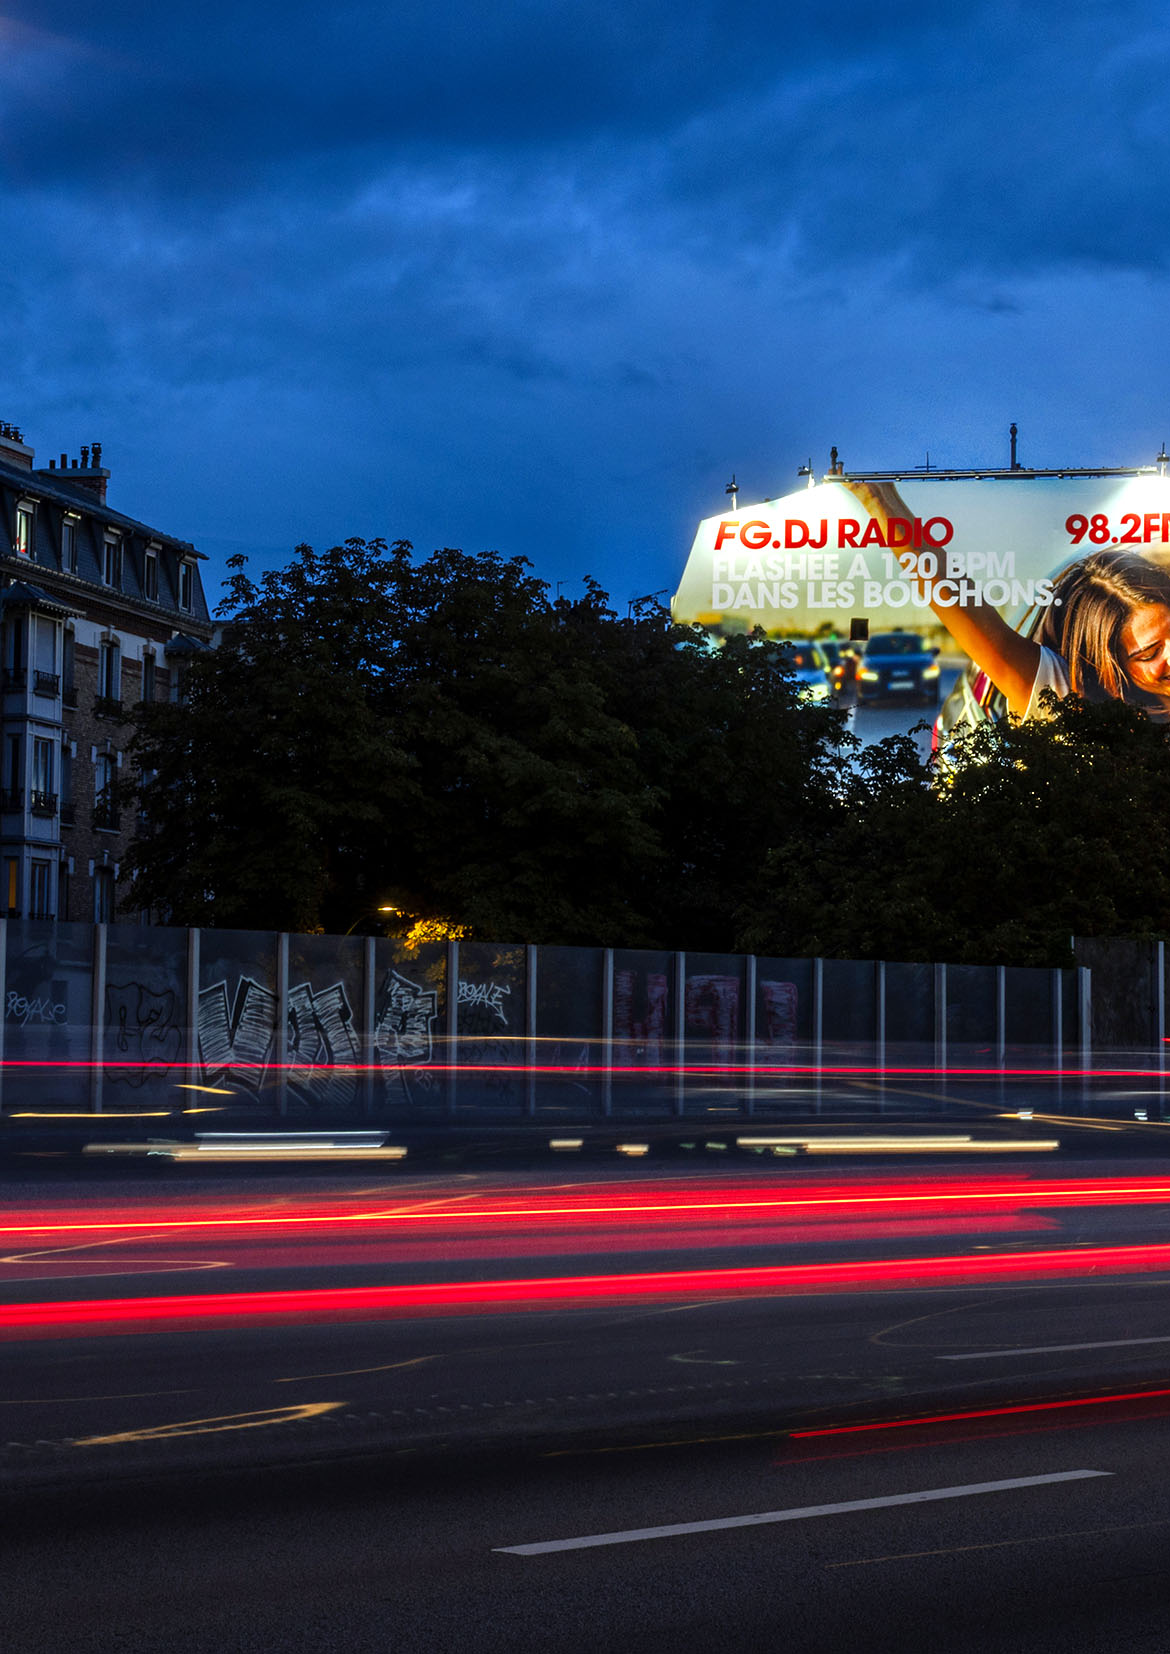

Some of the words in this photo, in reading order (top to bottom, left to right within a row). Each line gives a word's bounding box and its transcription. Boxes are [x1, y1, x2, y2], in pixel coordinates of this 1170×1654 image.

[714, 519, 828, 550] FG.DJ
[838, 517, 954, 548] RADIO
[881, 552, 938, 580] 120
[946, 551, 1015, 579] BPM
[712, 582, 799, 609] DANS
[807, 581, 855, 609] LES
[863, 578, 1062, 608] BOUCHONS.
